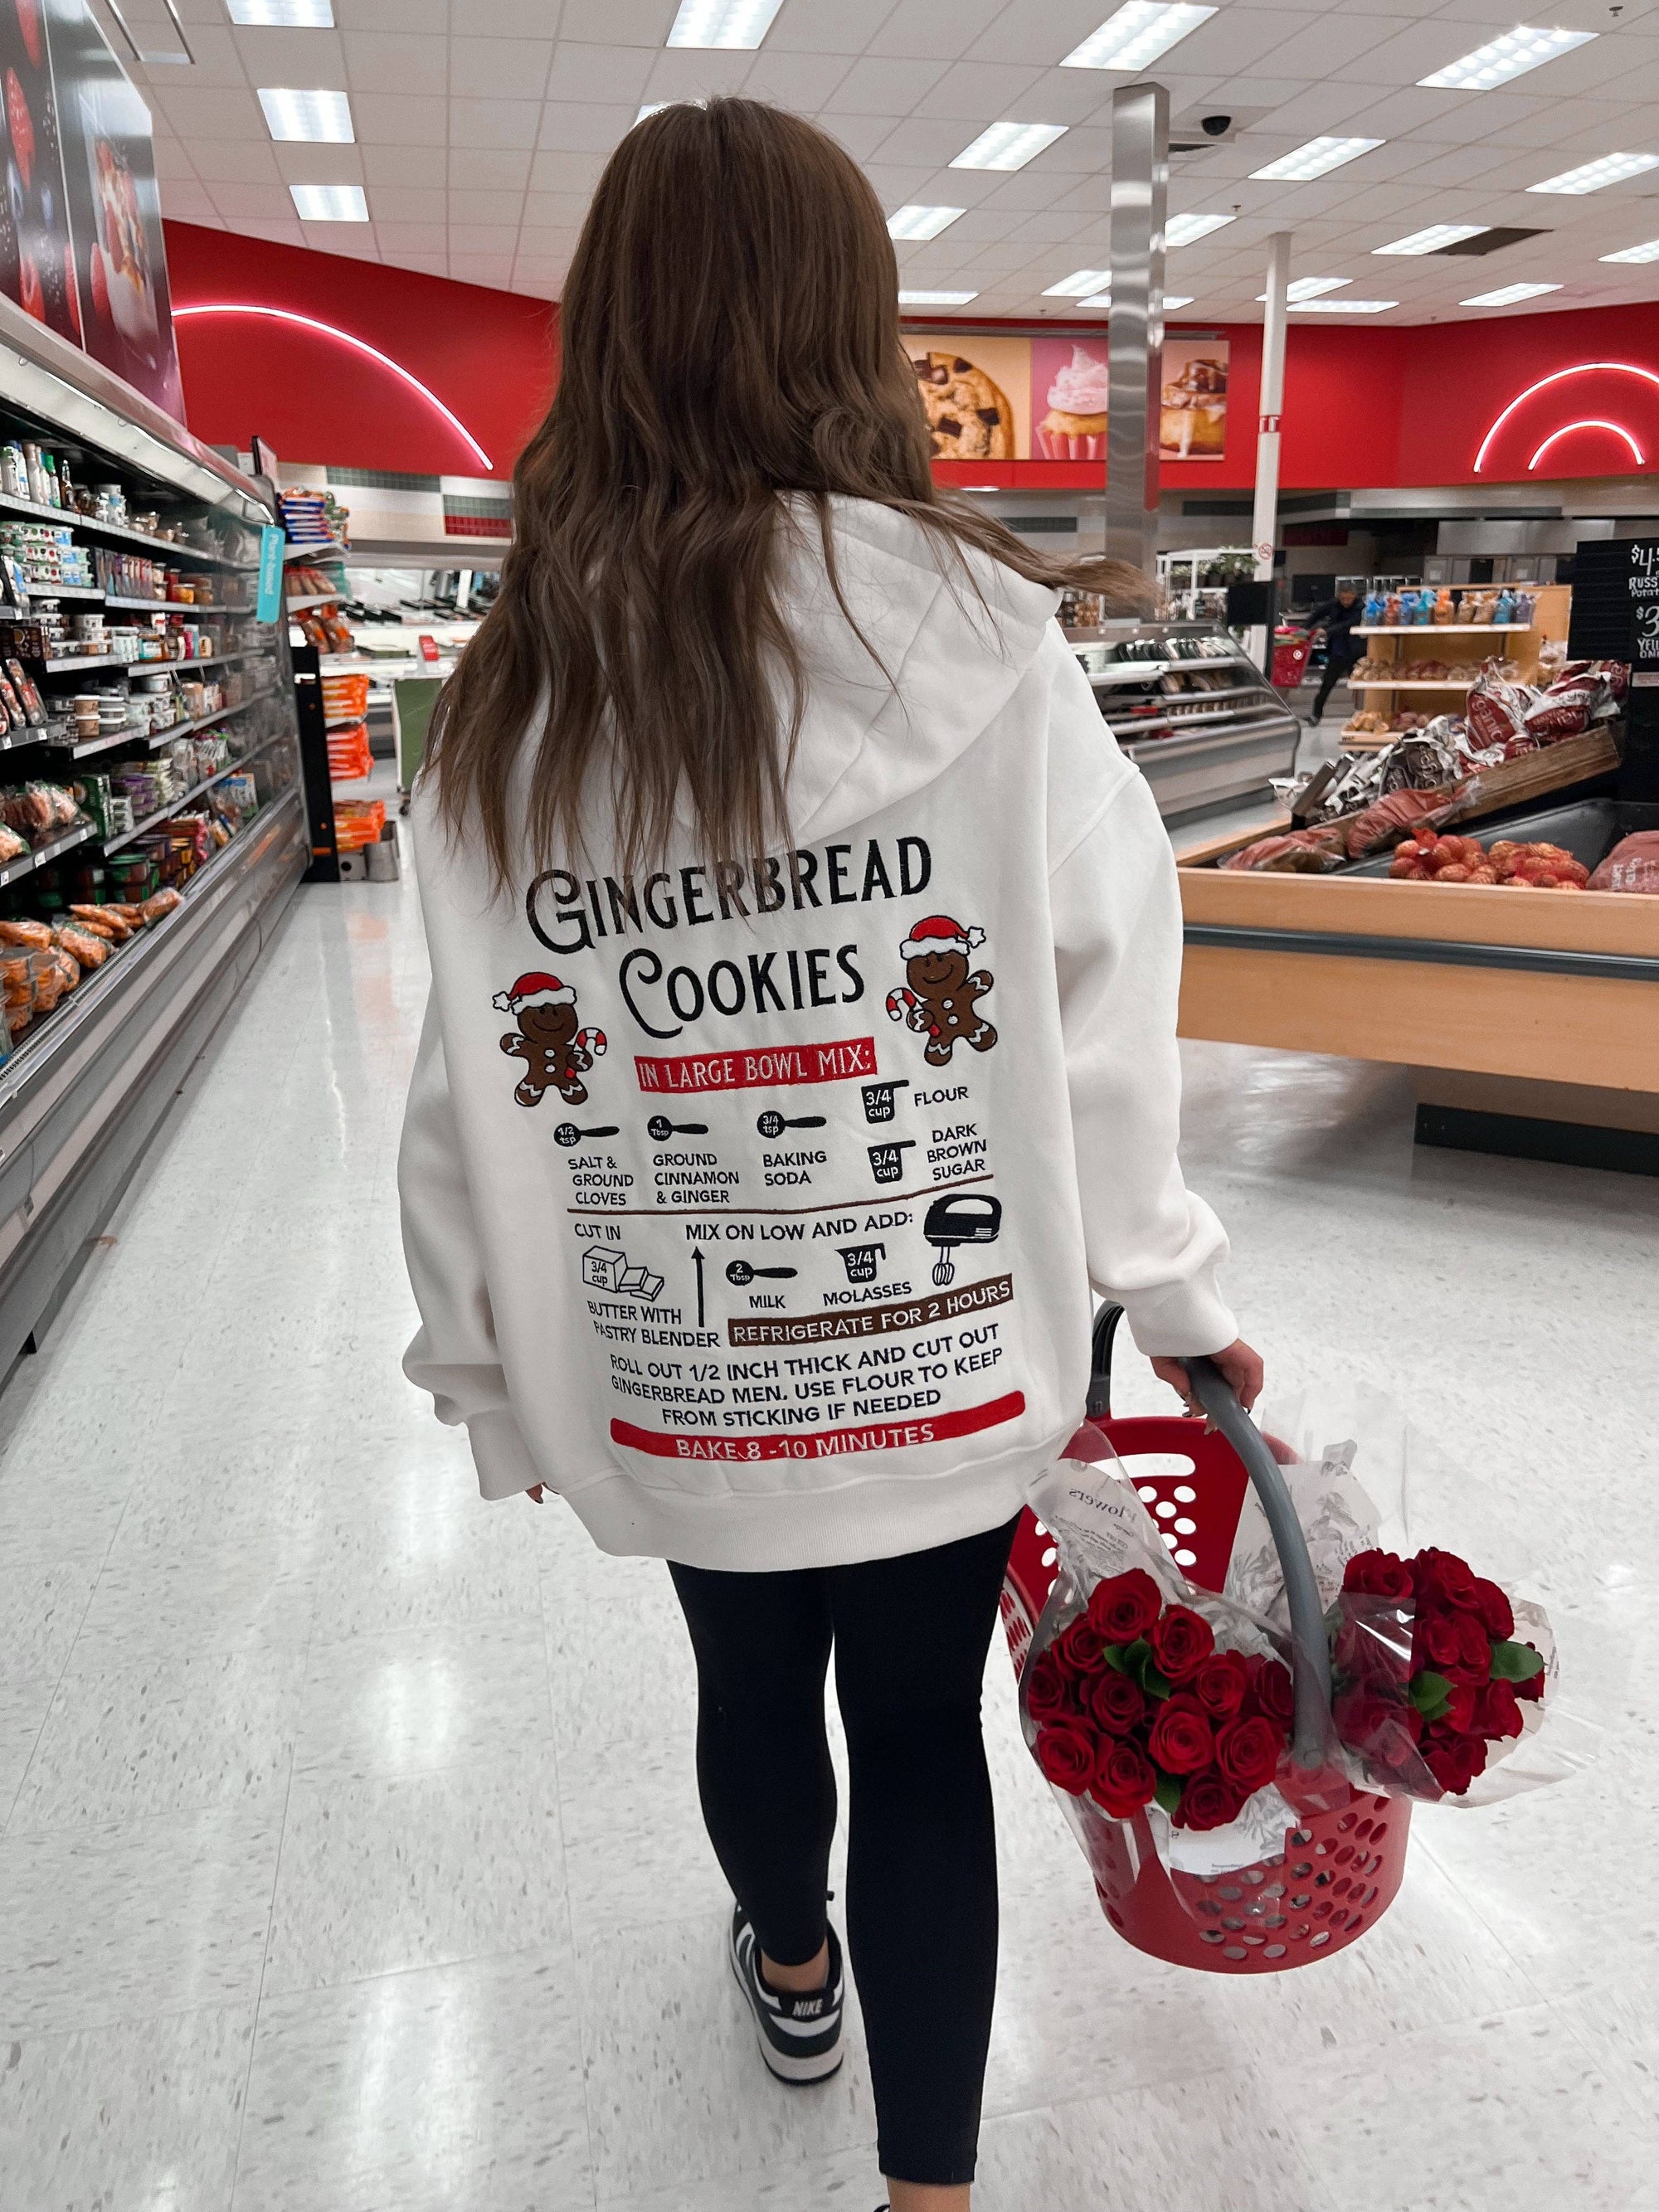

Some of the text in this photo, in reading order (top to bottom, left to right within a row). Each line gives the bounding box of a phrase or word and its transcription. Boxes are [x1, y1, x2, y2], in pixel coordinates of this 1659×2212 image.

[638, 1043, 871, 1088] IN LARGE BOWL MIX:
[865, 1088, 892, 1106] 3/4
[914, 1086, 969, 1107] FLOUR
[762, 1114, 780, 1125] 3/4
[868, 1105, 891, 1120] cup
[557, 1125, 575, 1137] 1/2
[650, 1128, 669, 1137] Tbsp
[762, 1124, 780, 1135] tsp
[932, 1123, 978, 1144] DARK
[559, 1135, 577, 1145] tsp
[762, 1150, 828, 1168] BAKING
[872, 1149, 899, 1167] 3/4
[927, 1139, 987, 1164] BROWN
[567, 1155, 618, 1170] SALT &
[652, 1153, 718, 1167] GROUND
[654, 1170, 740, 1186] CINNAMON
[764, 1169, 812, 1187] SODA
[876, 1164, 899, 1179] cup
[932, 1159, 986, 1181] SUGAR
[572, 1173, 634, 1188] GROUND
[575, 1191, 627, 1206] CLOVES
[656, 1189, 731, 1204] & GINGER
[574, 1223, 621, 1241] CUT IN
[685, 1211, 913, 1241] MIX ON LOW AND ADD:
[846, 1250, 875, 1266] 3/4
[591, 1260, 608, 1274] 3/4
[735, 1263, 744, 1274] 2
[849, 1265, 874, 1279] cup
[591, 1274, 609, 1287] cup
[729, 1273, 751, 1282] Tbsp
[748, 1295, 786, 1309] MILK
[822, 1281, 912, 1307] MOLASSES
[586, 1300, 682, 1325] BUTTER WITH
[733, 1280, 1011, 1344] REFRIGERATE FOR 2 HOURS
[592, 1320, 721, 1349] PASTRY BLENDER
[610, 1323, 999, 1383] ROLL OUT 1/2 INCH THICK AND CUT OUT
[611, 1347, 1003, 1404] GINGERBREAD MEN. USE FLOUR TO KEEP
[661, 1389, 941, 1427] FROM STICKING IF NEEDED
[676, 1439, 739, 1461] BAKE
[747, 1440, 761, 1461] 8
[815, 1422, 936, 1458] MINUTES
[792, 1999, 823, 2016] NIKE
